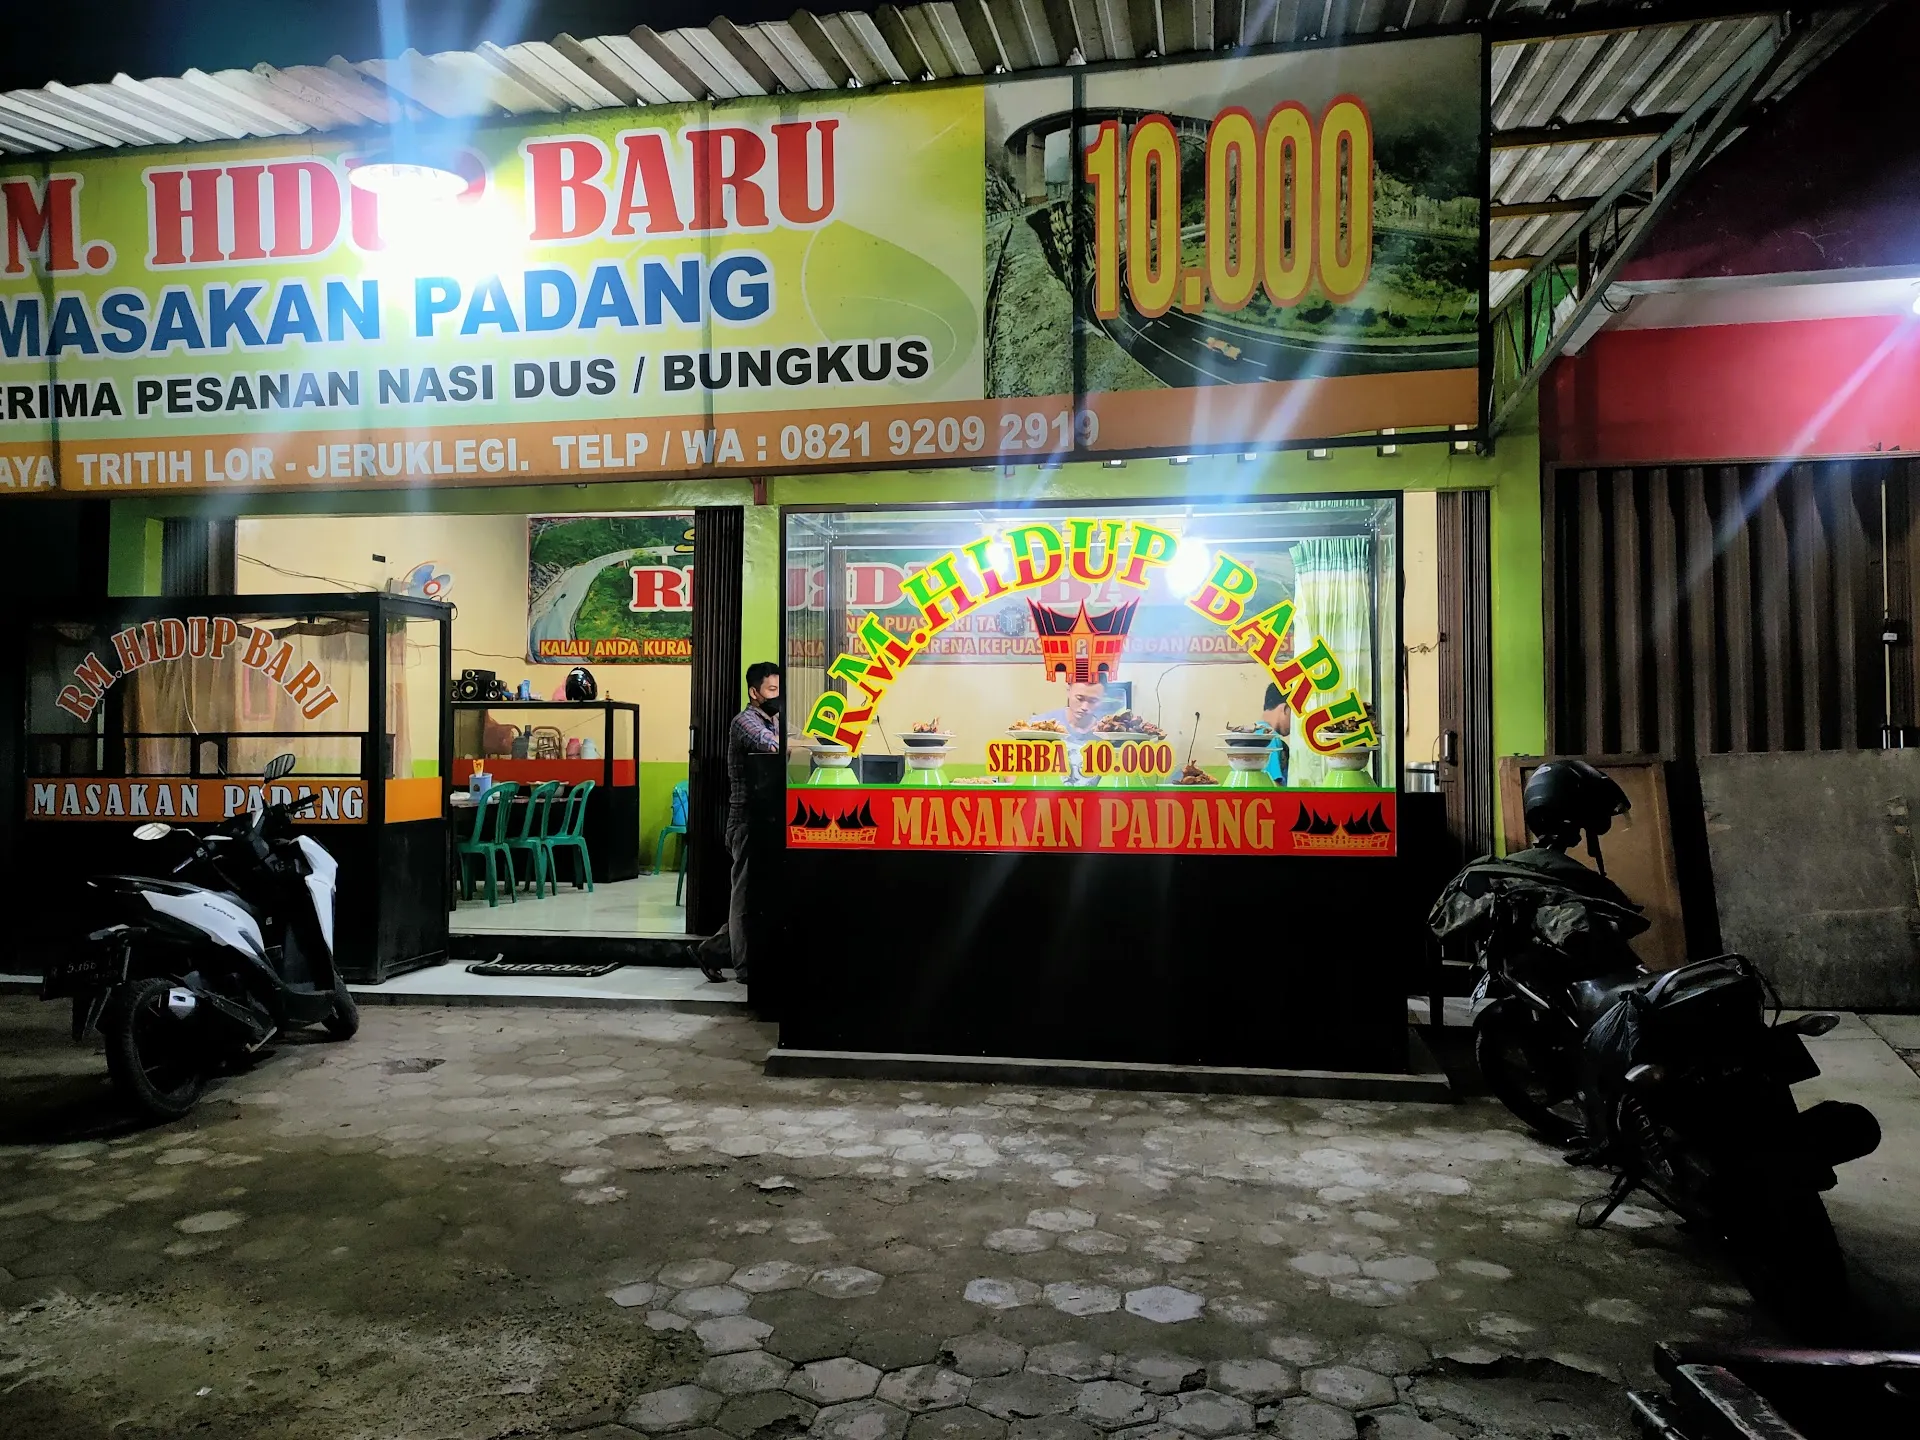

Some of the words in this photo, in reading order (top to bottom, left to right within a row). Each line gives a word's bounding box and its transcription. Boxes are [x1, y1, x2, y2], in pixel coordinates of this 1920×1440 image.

[148, 150, 487, 266] HID
[526, 119, 839, 241] BARU
[1085, 93, 1374, 320] 10.000
[0, 279, 380, 358] MASAKAN
[415, 254, 770, 338] PADANG
[137, 370, 360, 415] PESANAN
[378, 363, 494, 406] NASI
[514, 357, 616, 399] DUS
[632, 355, 646, 394] /
[663, 340, 930, 392] BUNGKUS
[77, 450, 192, 486] TRITIH
[205, 445, 275, 482] LOR
[285, 463, 296, 471] -
[308, 438, 530, 479] JERUKLEGI.
[552, 432, 648, 470] TELP
[660, 430, 671, 466] /
[780, 420, 870, 461] 0821
[889, 414, 985, 456] 9209
[1000, 408, 1099, 451] 2919
[55, 652, 123, 723] RM.
[111, 616, 238, 674] HIDUP
[242, 626, 338, 720] BARU
[540, 640, 590, 656] KALAU
[594, 640, 639, 656] ANDA
[803, 611, 929, 757] RM.
[899, 517, 1181, 636] HIDUP
[1189, 551, 1379, 755] BARU
[919, 637, 976, 655] ARENA
[988, 743, 1067, 774] SERBA
[1082, 743, 1173, 775] 10.000
[33, 783, 199, 817] MASAKAN
[223, 785, 363, 820] PADANG
[892, 796, 1083, 849] MASAKAN
[1100, 797, 1274, 850] PADANG
